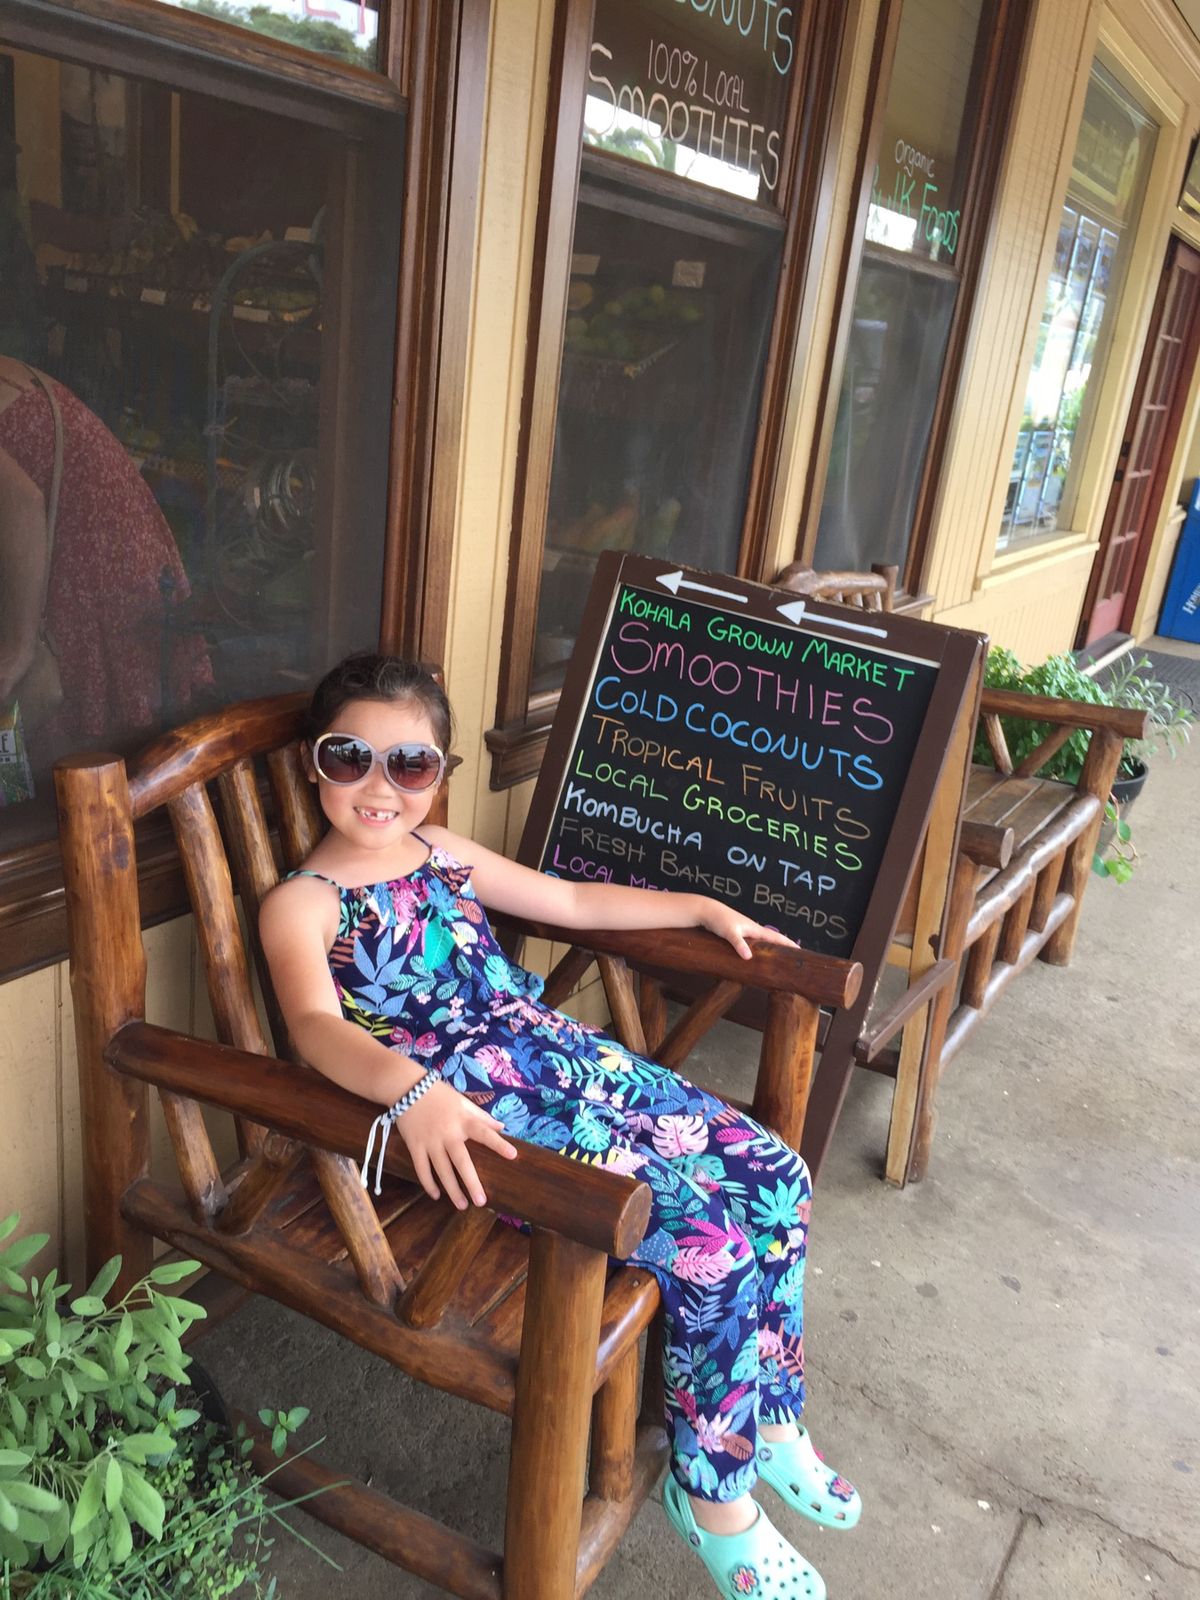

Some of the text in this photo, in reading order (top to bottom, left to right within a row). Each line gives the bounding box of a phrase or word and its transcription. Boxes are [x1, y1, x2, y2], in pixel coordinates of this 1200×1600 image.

[648, 39, 750, 113] 100% LOCAL
[620, 589, 915, 691] KOHALA GROWN MARKET
[592, 714, 871, 840] TROPICAL FRUITS
[595, 676, 883, 790] COLD COCONUTS
[553, 844, 615, 884] LOCAL
[575, 749, 863, 871] LOCAL GROCERIES
[560, 817, 646, 862] FRESH
[660, 850, 741, 897] BAKED
[753, 884, 848, 939] BREADS
[727, 846, 766, 872] ON
[779, 860, 837, 896] TAP
